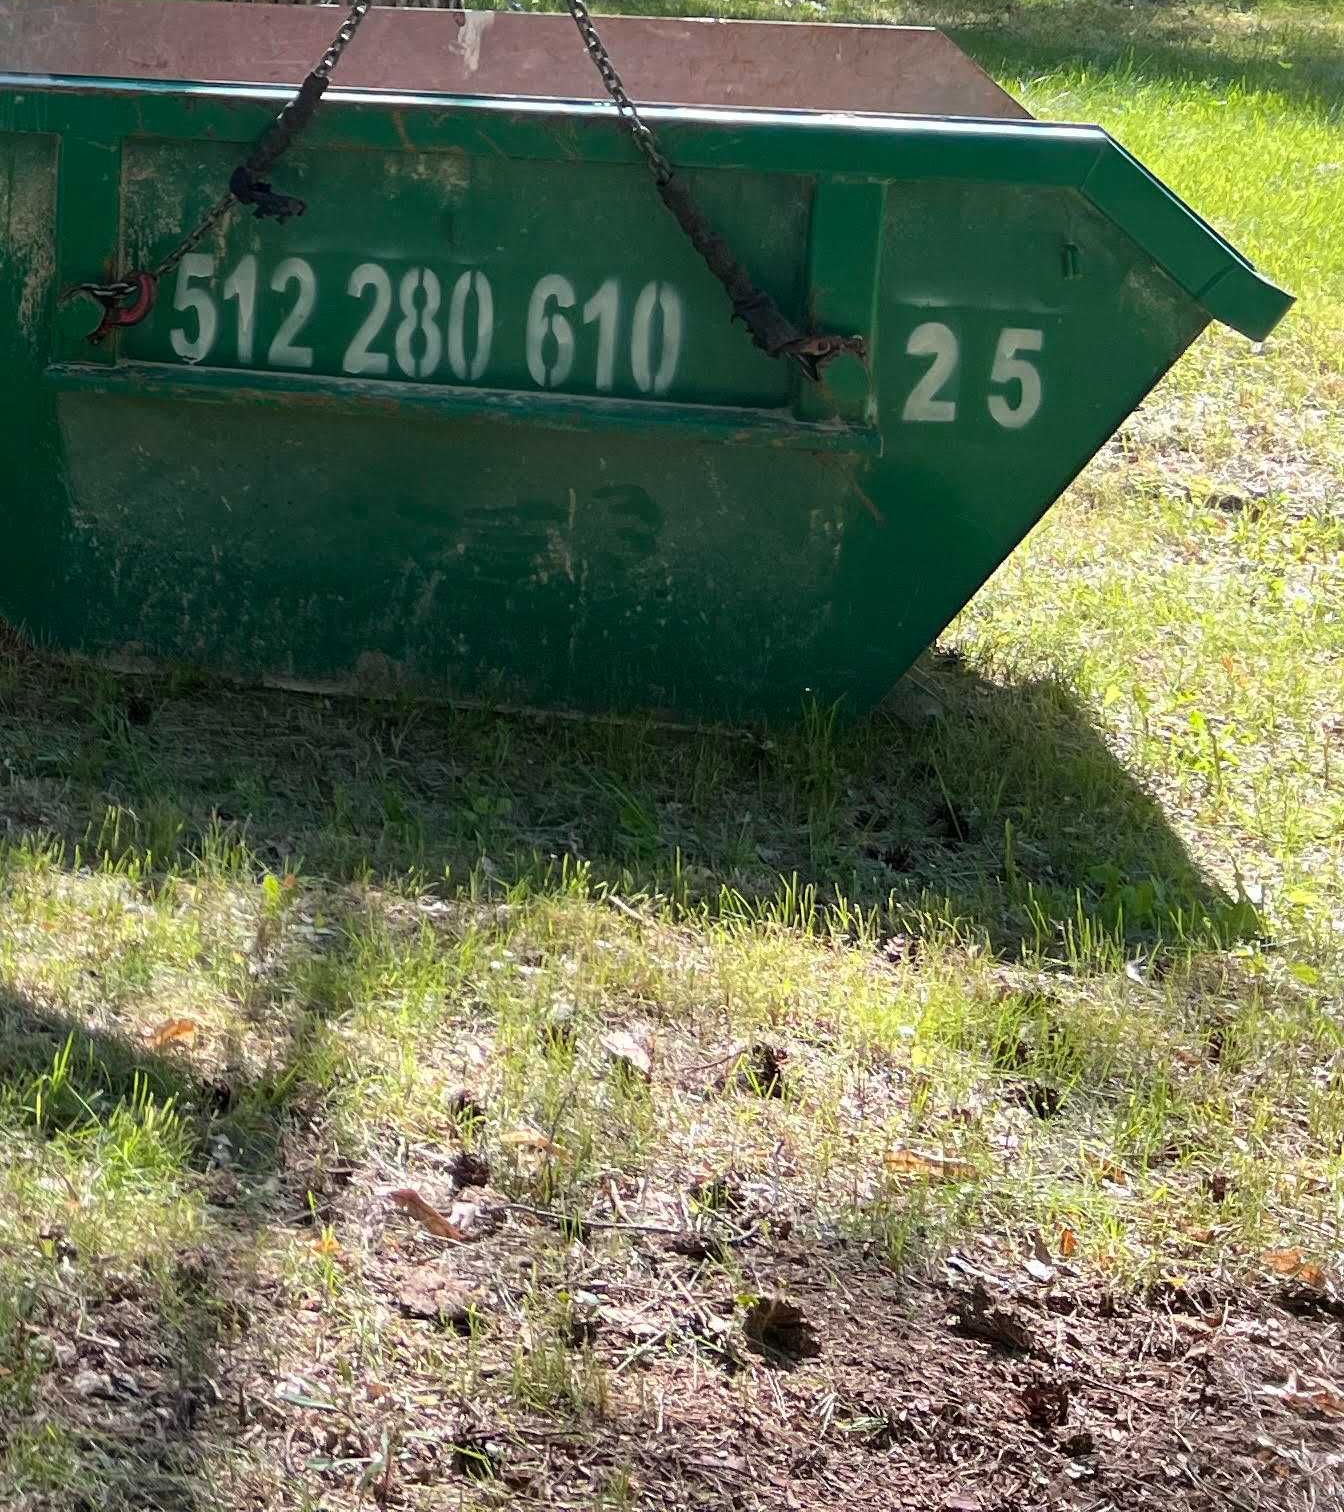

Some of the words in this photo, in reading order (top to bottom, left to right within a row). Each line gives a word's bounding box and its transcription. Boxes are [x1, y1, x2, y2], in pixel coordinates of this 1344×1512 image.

[170, 253, 316, 368] 512
[343, 263, 494, 380] 280
[526, 273, 681, 394] 610
